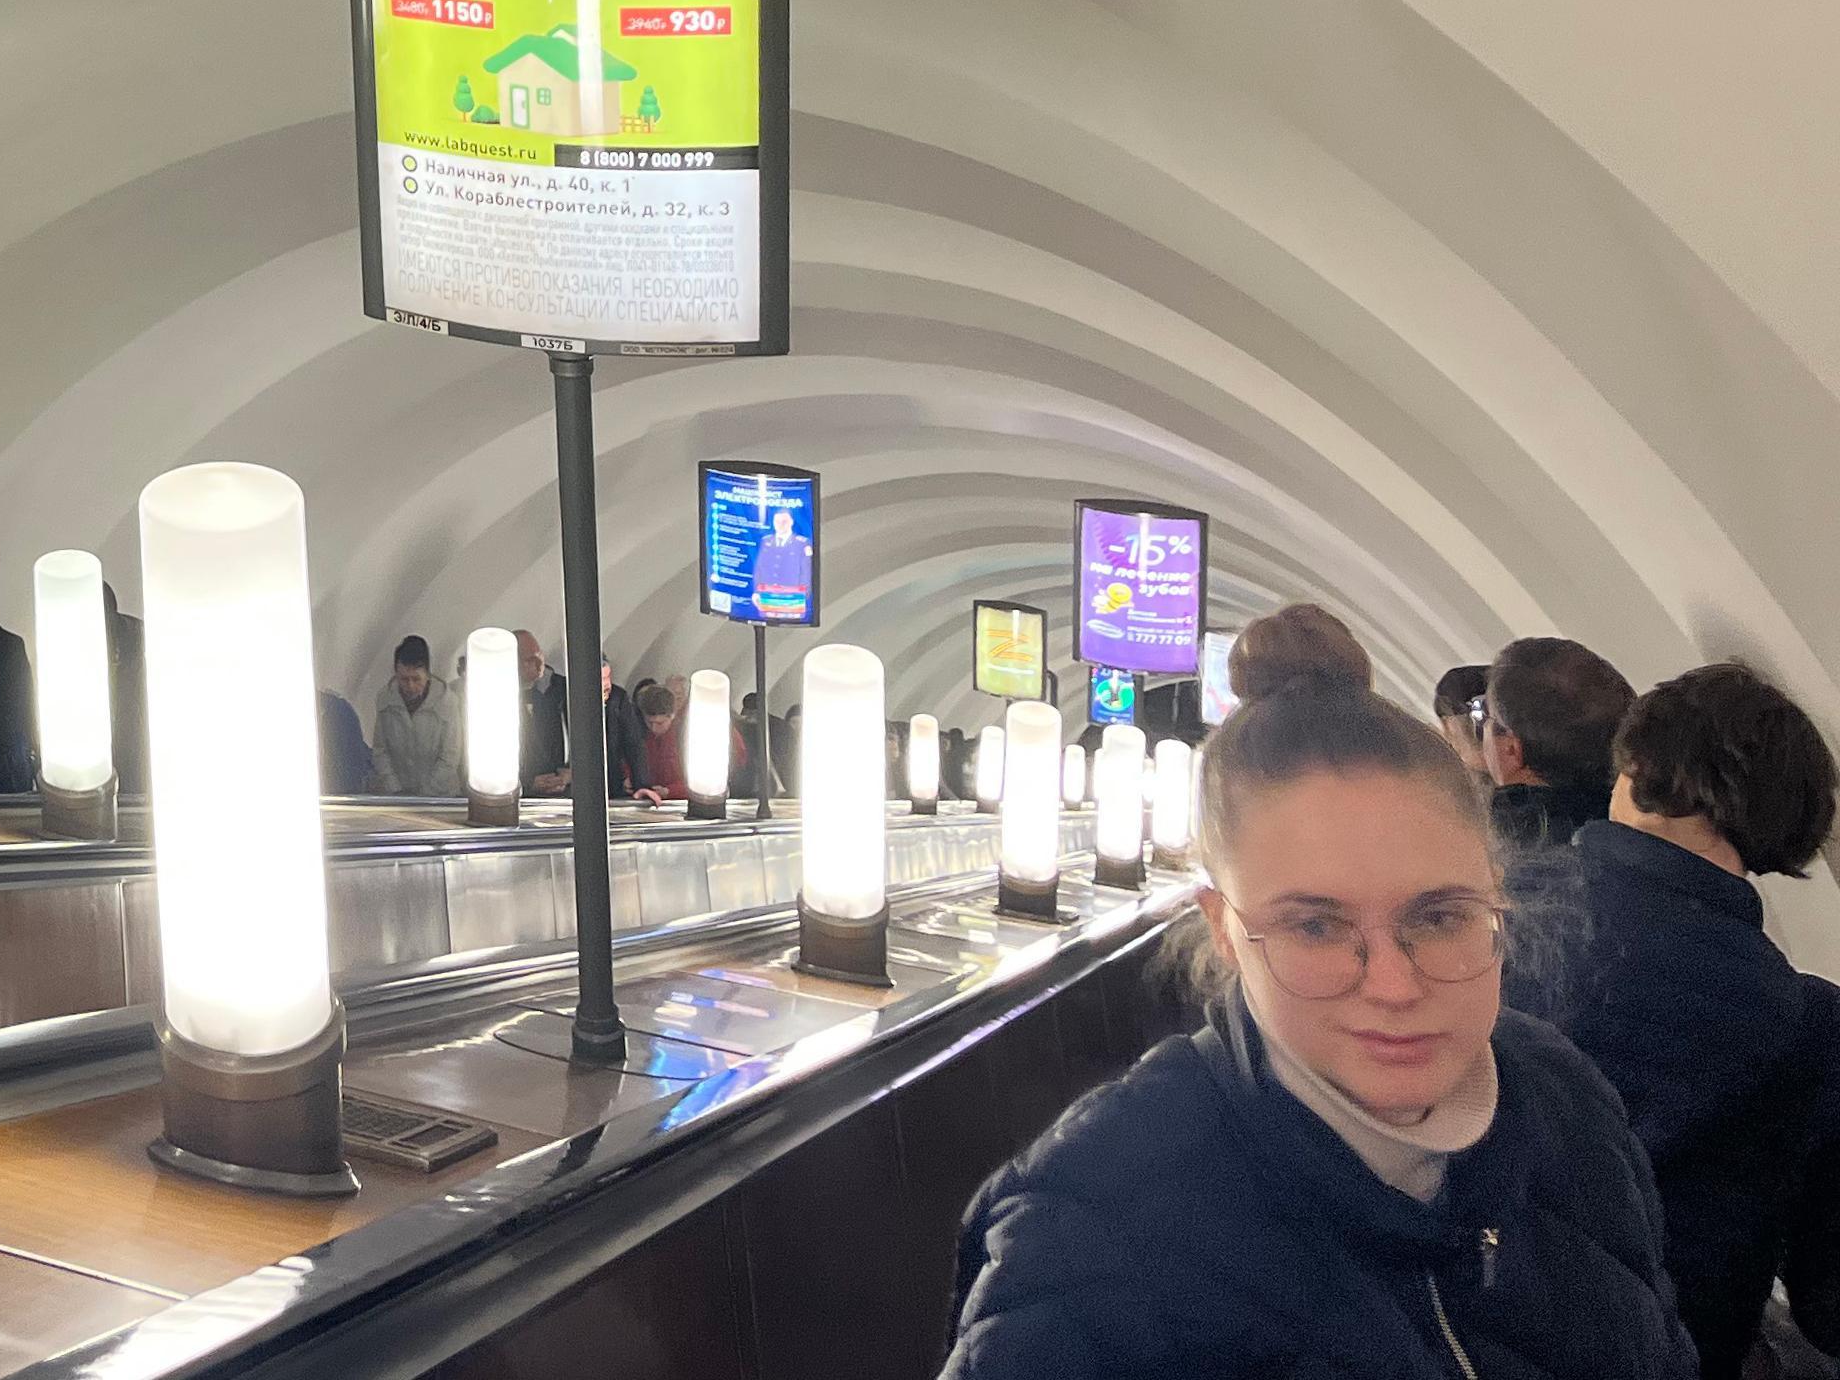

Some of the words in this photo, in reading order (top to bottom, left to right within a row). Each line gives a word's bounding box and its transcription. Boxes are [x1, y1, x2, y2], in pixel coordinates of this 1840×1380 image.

[404, 131, 537, 160] www.labquest.ru
[580, 150, 590, 165] 8
[593, 150, 634, 168] (800)
[638, 152, 648, 167] 7
[651, 152, 681, 167] 000
[684, 151, 715, 167] 999
[425, 158, 506, 184] Наличная
[511, 174, 541, 190] ул.,
[546, 178, 562, 192] д.
[568, 176, 594, 194] 40,
[601, 180, 616, 193] к.
[425, 180, 449, 198] Ул.
[453, 186, 637, 218] Кораблестроителей,
[642, 204, 658, 218] д.
[664, 202, 692, 218] 32,
[699, 204, 713, 216] к.
[720, 201, 730, 216] 3
[398, 247, 462, 279] ИМЕЮТСЯ
[632, 277, 739, 300] НЕОБХОДИМО
[399, 270, 481, 306] ПОЛУЧЕНИЕ
[486, 288, 610, 320] КОНСУЛЬТАЦИИ
[616, 299, 740, 324] СПЕЦИАЛИСТА
[533, 336, 574, 351] 1037Б
[714, 490, 804, 509] ЭЛЕКТРООЕЗДА
[1139, 583, 1191, 597] зубов
